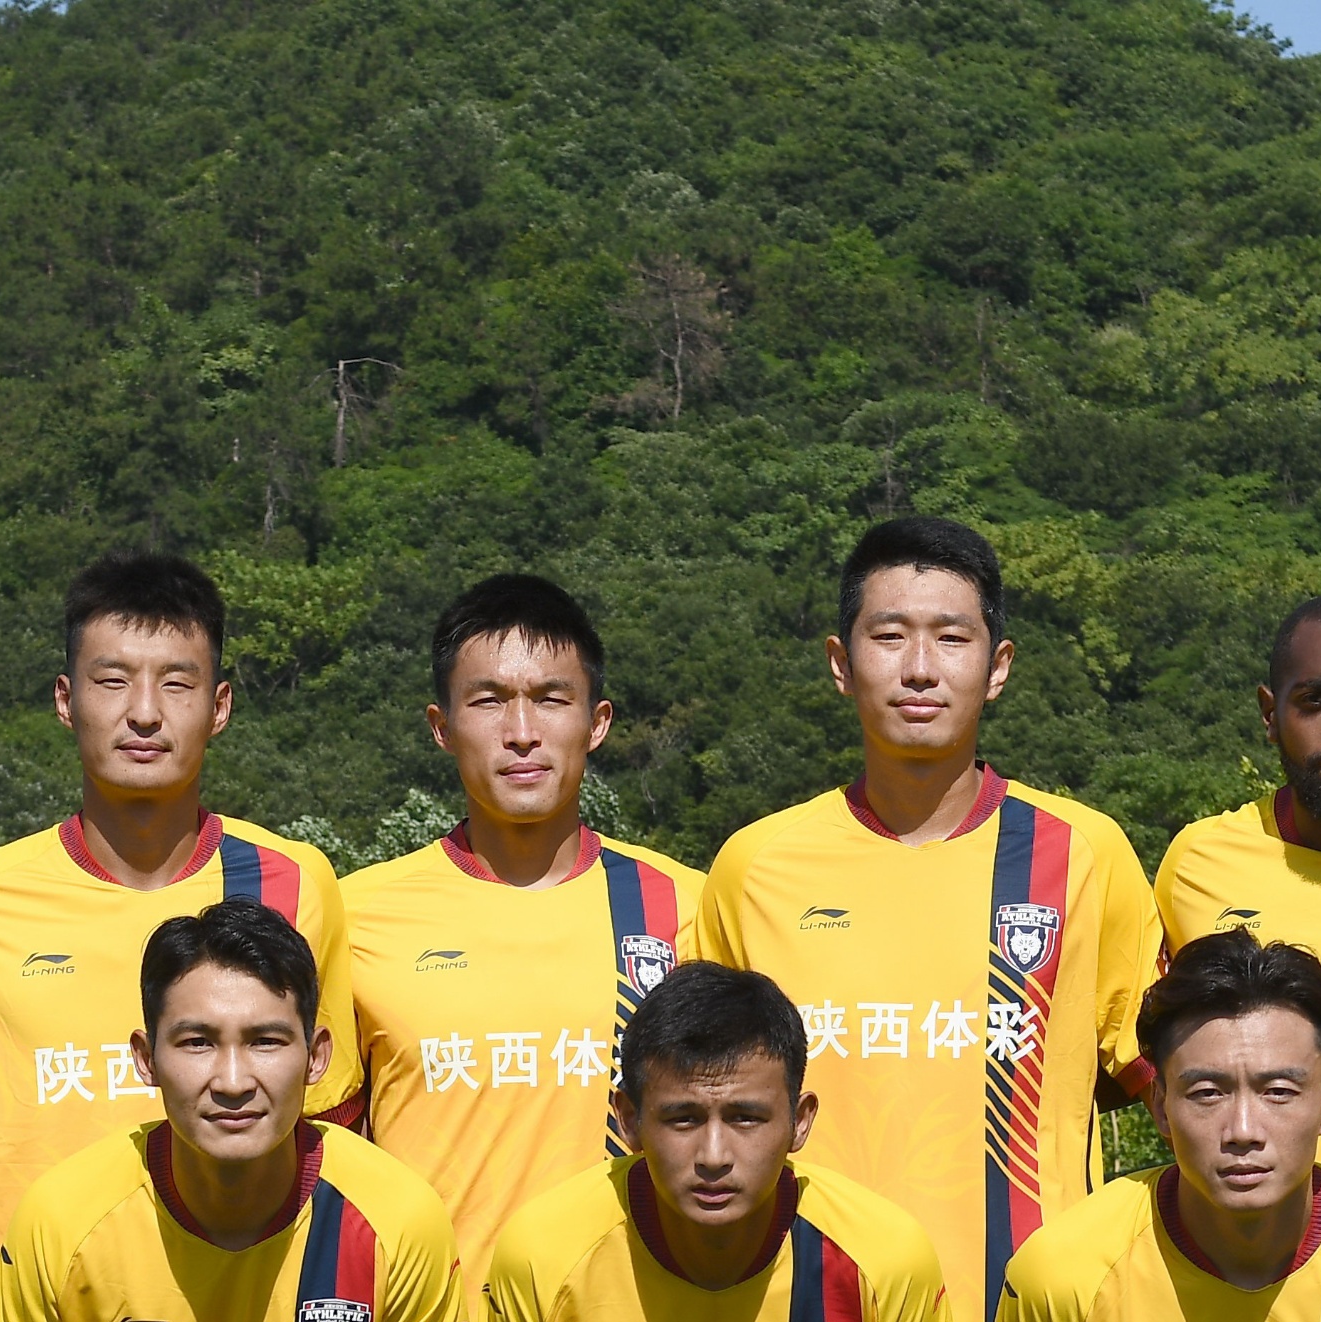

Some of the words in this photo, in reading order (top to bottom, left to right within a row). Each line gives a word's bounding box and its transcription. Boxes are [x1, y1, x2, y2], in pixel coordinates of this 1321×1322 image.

[799, 920, 851, 931] LI-NING
[22, 965, 75, 977] LI-NING
[415, 961, 468, 972] LI-NING
[798, 998, 1039, 1061] 陕西体彩
[420, 1027, 623, 1092] 陕西体
[305, 1309, 365, 1322] ATHLETIC
